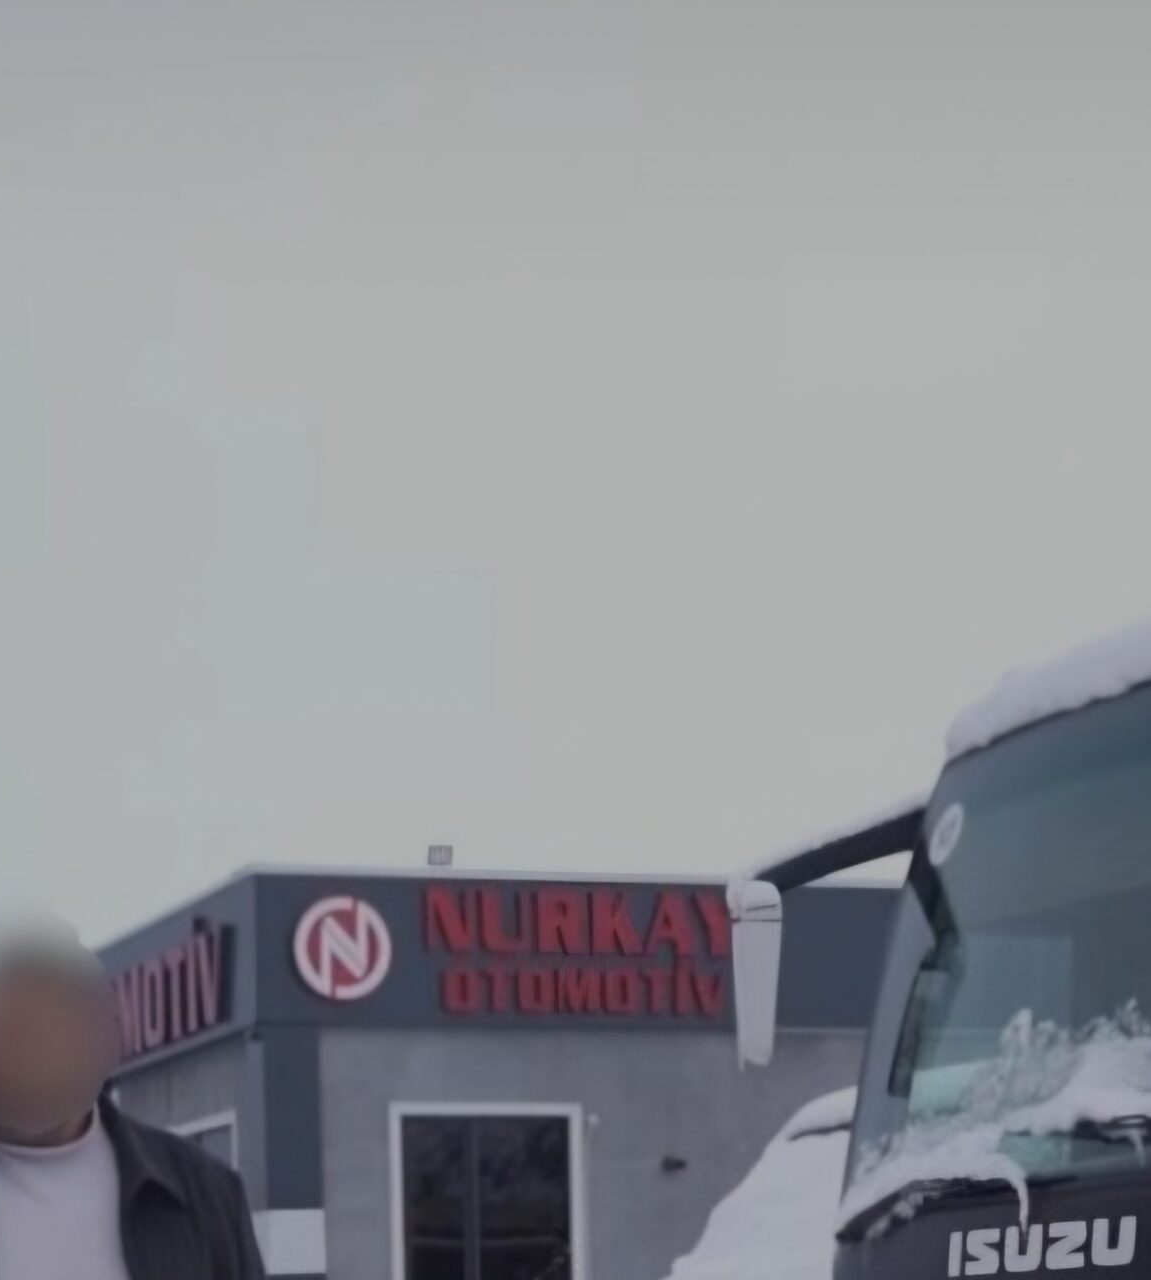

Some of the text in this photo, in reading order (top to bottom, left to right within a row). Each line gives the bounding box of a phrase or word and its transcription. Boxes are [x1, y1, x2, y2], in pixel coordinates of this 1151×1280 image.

[426, 885, 730, 956] NURKAY
[113, 918, 224, 1057] MOTİV
[948, 1215, 1137, 1277] ISUZU
